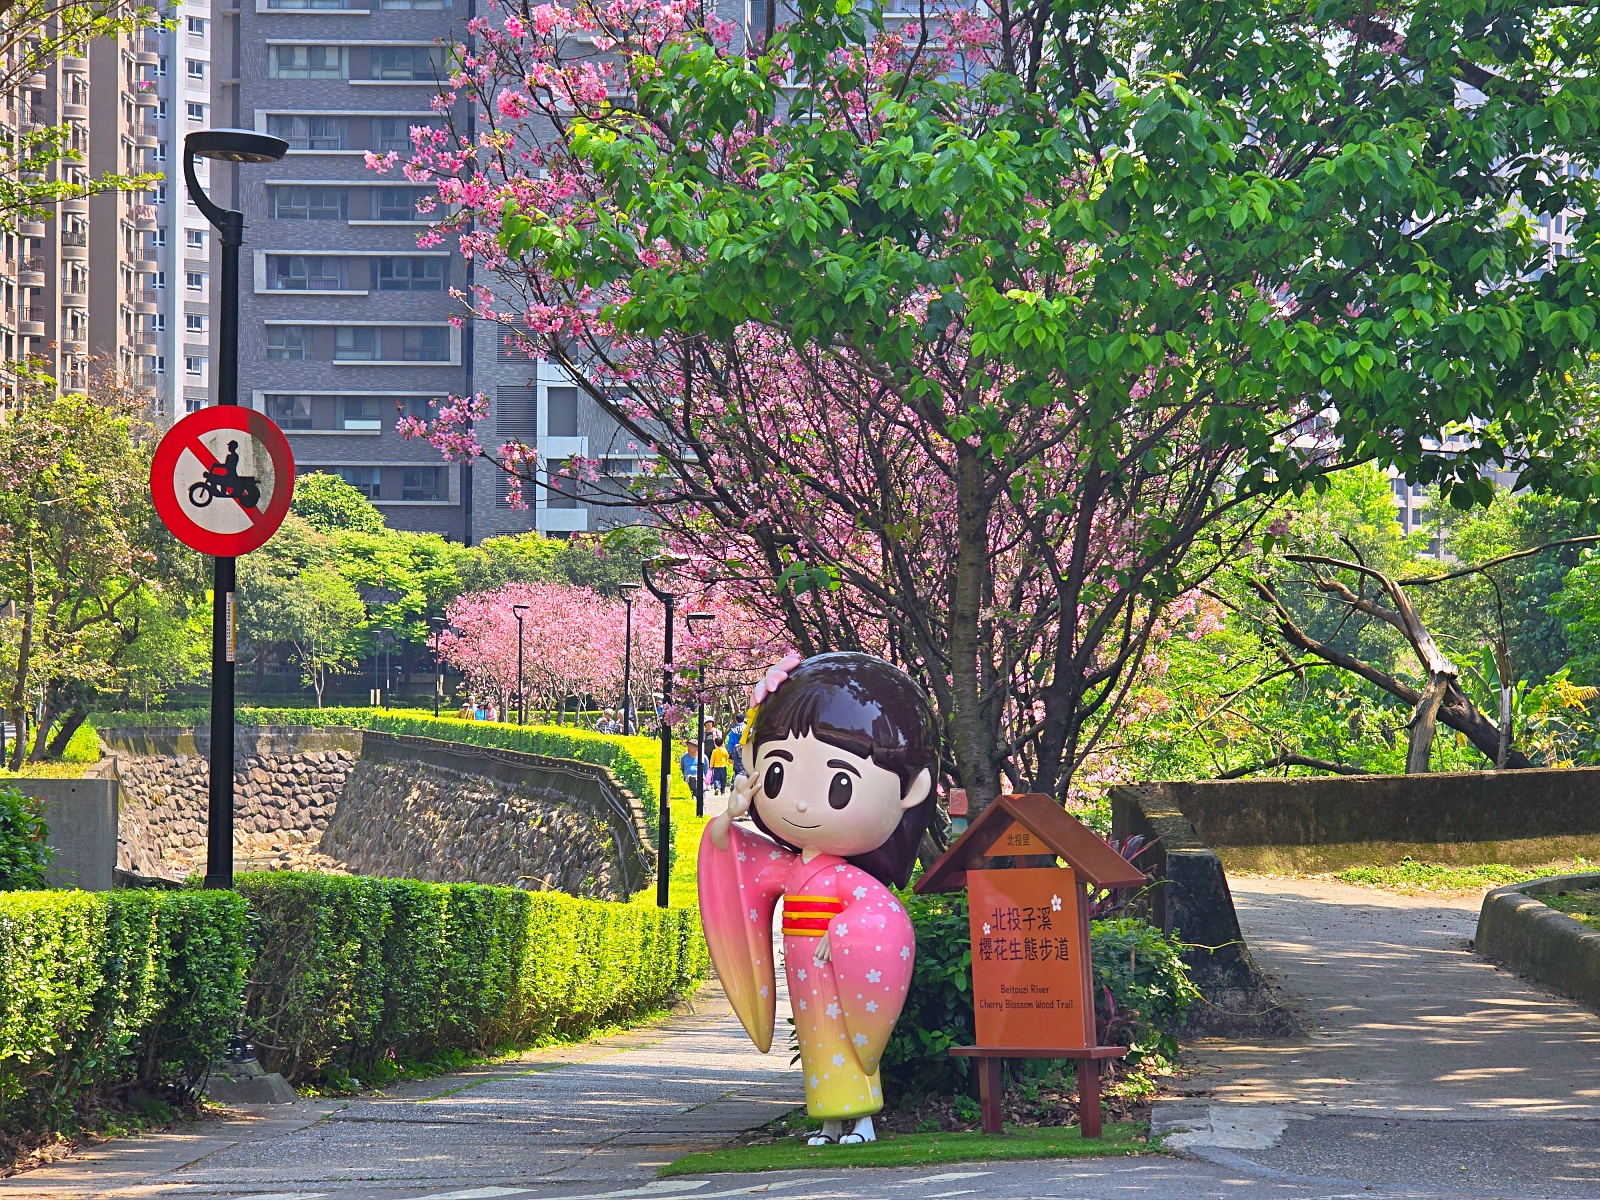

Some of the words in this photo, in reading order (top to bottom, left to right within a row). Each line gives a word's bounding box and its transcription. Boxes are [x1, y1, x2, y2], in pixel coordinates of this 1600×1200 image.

[1006, 833, 1031, 847] 北投里
[991, 906, 1052, 932] 北投子溪
[978, 937, 1069, 962] 櫻花生態步道
[1000, 984, 1029, 994] Beitouzi
[1030, 984, 1050, 994] River
[979, 999, 1003, 1011] Cherry
[1005, 999, 1034, 1009] Blossom
[1035, 999, 1054, 1009] Wood
[1056, 999, 1074, 1009] Trail
